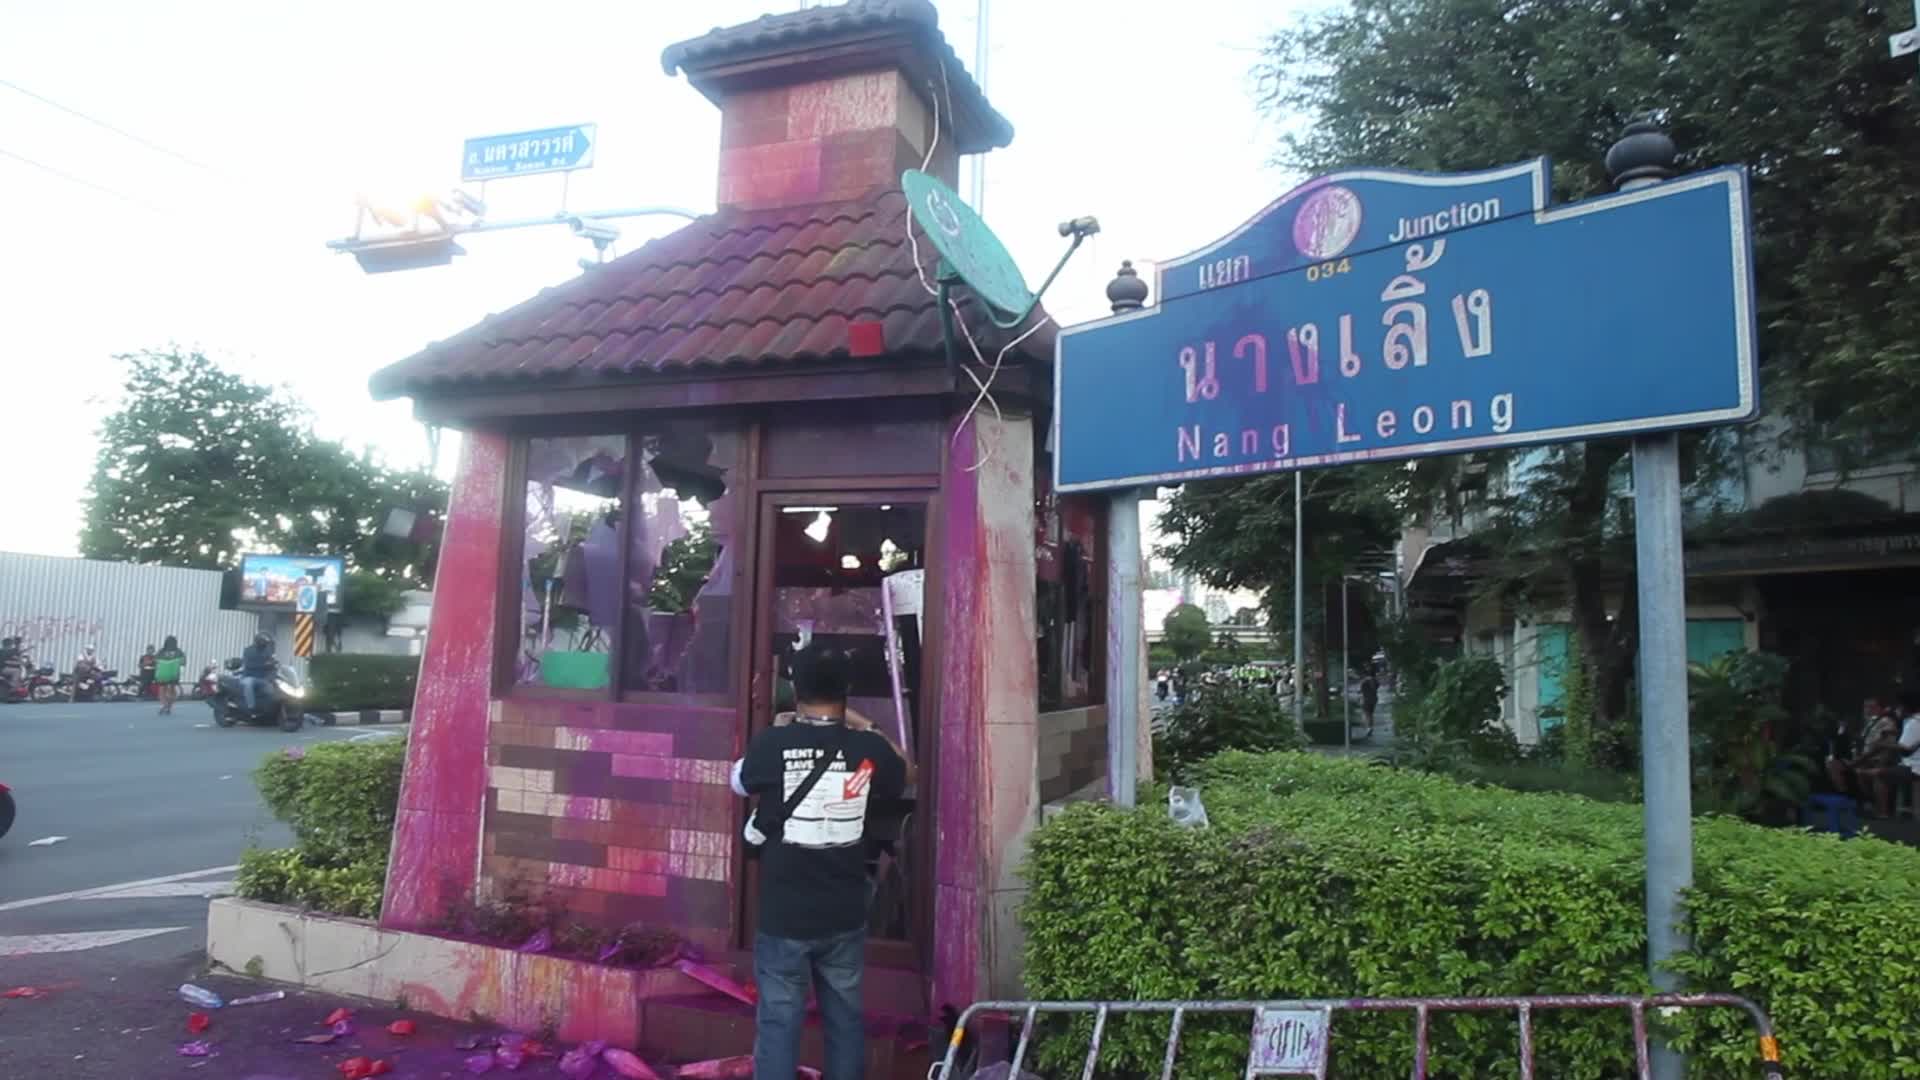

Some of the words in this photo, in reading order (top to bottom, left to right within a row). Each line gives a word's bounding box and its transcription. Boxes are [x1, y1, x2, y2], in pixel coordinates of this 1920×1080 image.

[1388, 197, 1501, 243] Junction
[1198, 254, 1251, 291] แยก
[1306, 258, 1353, 282] 034
[1178, 239, 1493, 403] นางเลิ้ง
[1177, 423, 1290, 462] Nang
[1336, 392, 1514, 443] Leong
[782, 748, 814, 760] RENT
